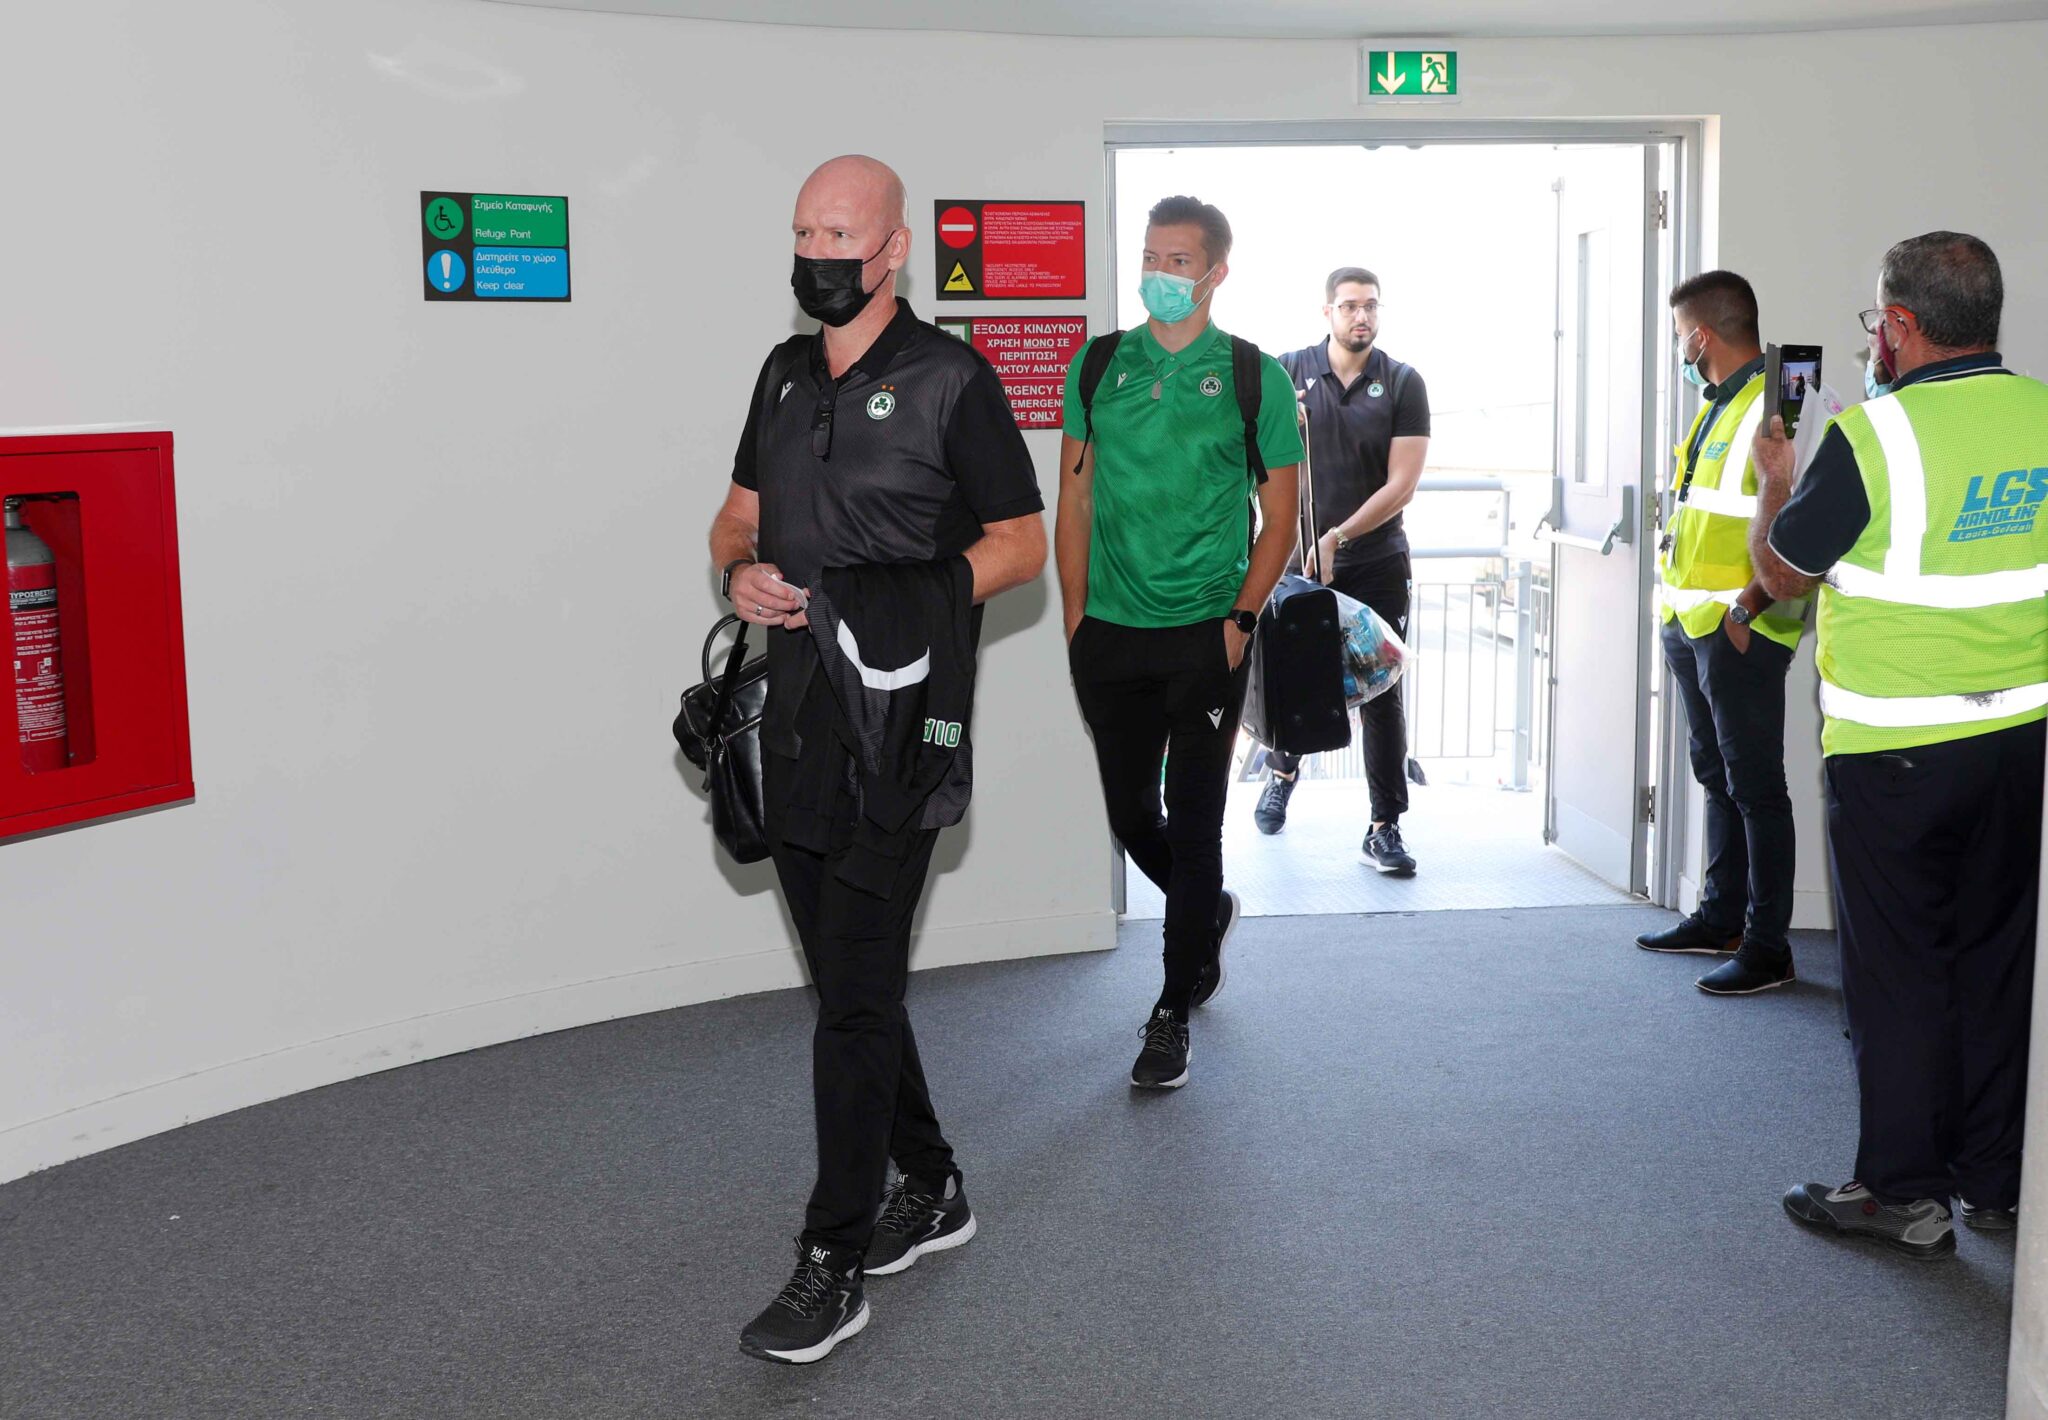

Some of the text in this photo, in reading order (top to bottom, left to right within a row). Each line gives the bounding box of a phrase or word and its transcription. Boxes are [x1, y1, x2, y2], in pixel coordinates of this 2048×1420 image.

[474, 200, 553, 213] Σημείο Καταφυγής
[475, 229, 531, 240] Refuge Point
[476, 252, 519, 263] Διατηρείτε
[533, 253, 556, 264] χώρο
[476, 265, 516, 276] ελεύθερο
[476, 281, 525, 292] Keep clear
[973, 323, 1083, 335] ΕΞΟΔΟΣ ΚΙΝΔΥΝΟΥ
[987, 338, 1070, 348] ΧΡΗΣΗ ΜΟΝΟ ΣΕ
[999, 351, 1058, 361] ΠΕΡΙΠΤΩΣΗ
[1032, 364, 1070, 373] ΑΝΑΓΚ
[1003, 384, 1065, 396] RGENCY E
[1011, 399, 1064, 409] EMERGEN
[1013, 411, 1057, 422] SE ONLY
[1960, 467, 2048, 513] LGS
